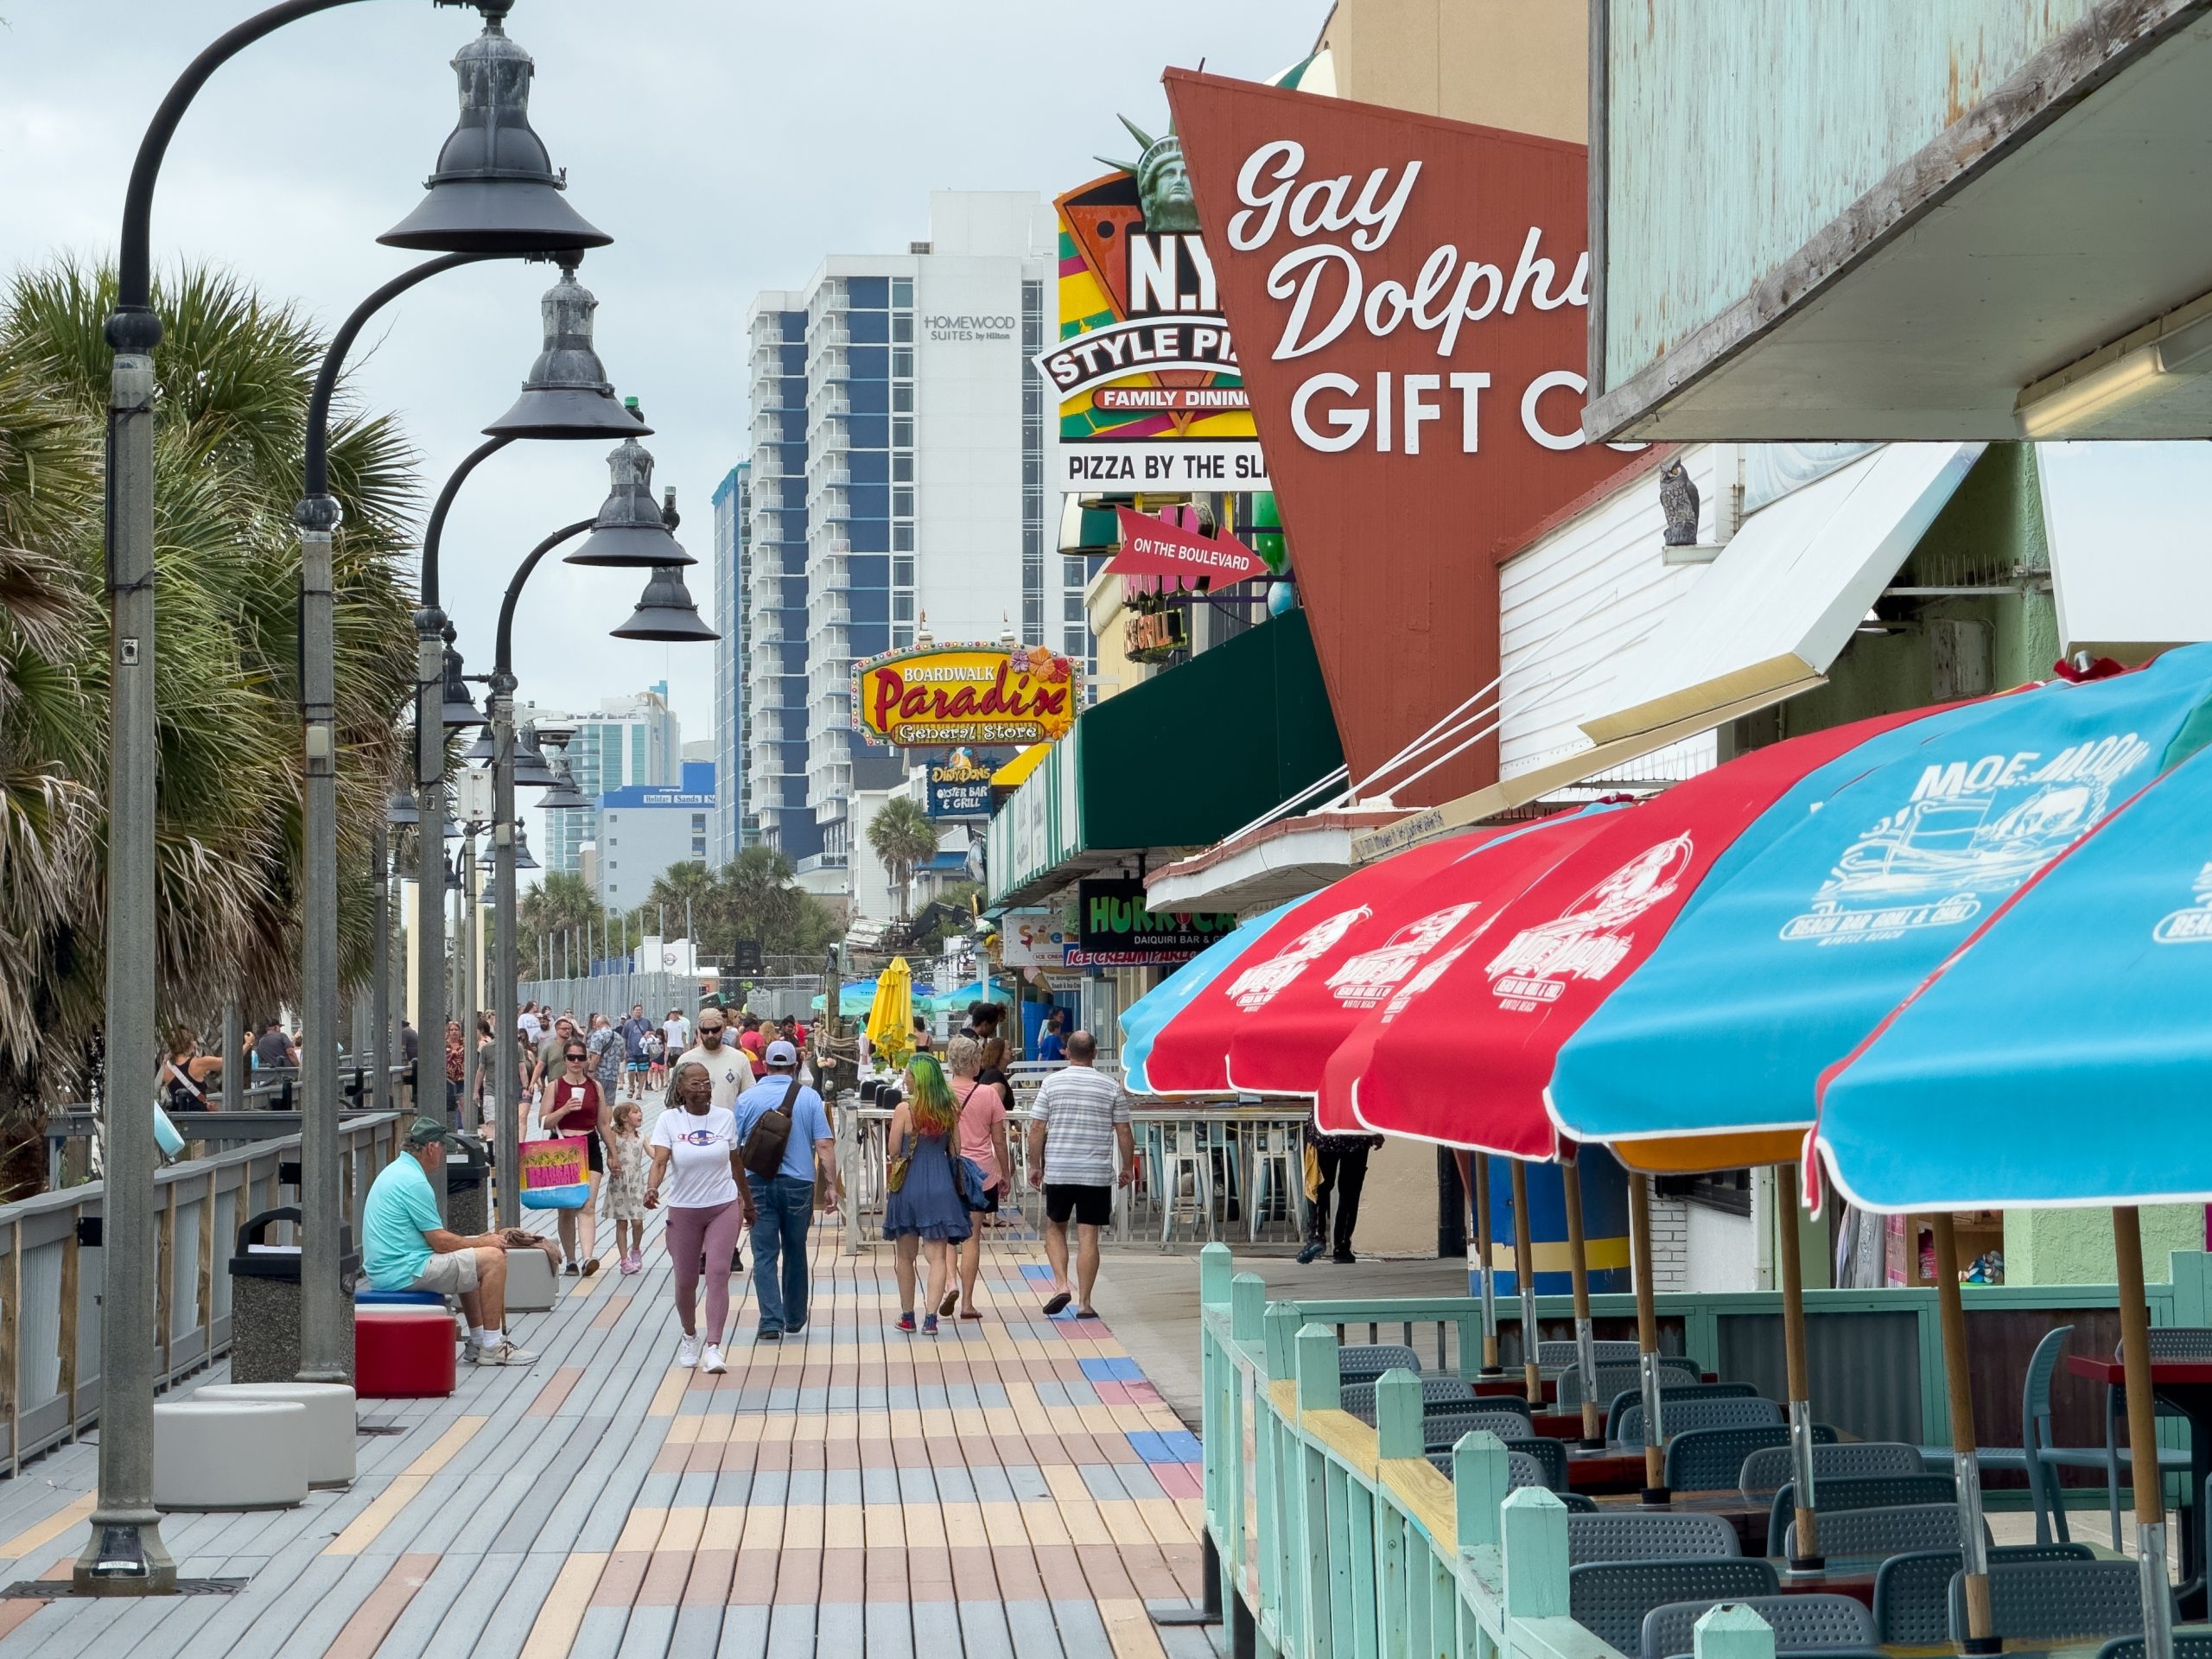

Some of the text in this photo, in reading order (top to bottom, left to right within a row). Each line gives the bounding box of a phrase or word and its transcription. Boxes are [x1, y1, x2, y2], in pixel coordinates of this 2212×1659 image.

[1227, 140, 1423, 251] Gay
[924, 315, 1015, 329] HOMEWOOD
[931, 330, 973, 340] SUITES
[976, 332, 985, 340] by
[1049, 327, 1237, 385] STYLE PI
[1104, 391, 1250, 406] FAMILY DININ
[1291, 372, 1491, 454] GIFT
[1069, 455, 1135, 479] PIZZA
[1145, 454, 1174, 479] BY
[1183, 454, 1224, 479] THE
[1134, 537, 1249, 571] ON THE BOULEVARD
[904, 666, 996, 683] BOARDWALK
[874, 659, 1067, 732] Paradise
[899, 725, 1038, 741] General Store
[1909, 752, 2041, 803] MOE
[937, 786, 988, 798] OYSTER BAR
[943, 798, 981, 810] & GRILL
[1066, 950, 1092, 966] ICE
[1093, 950, 1148, 965] CREAM
